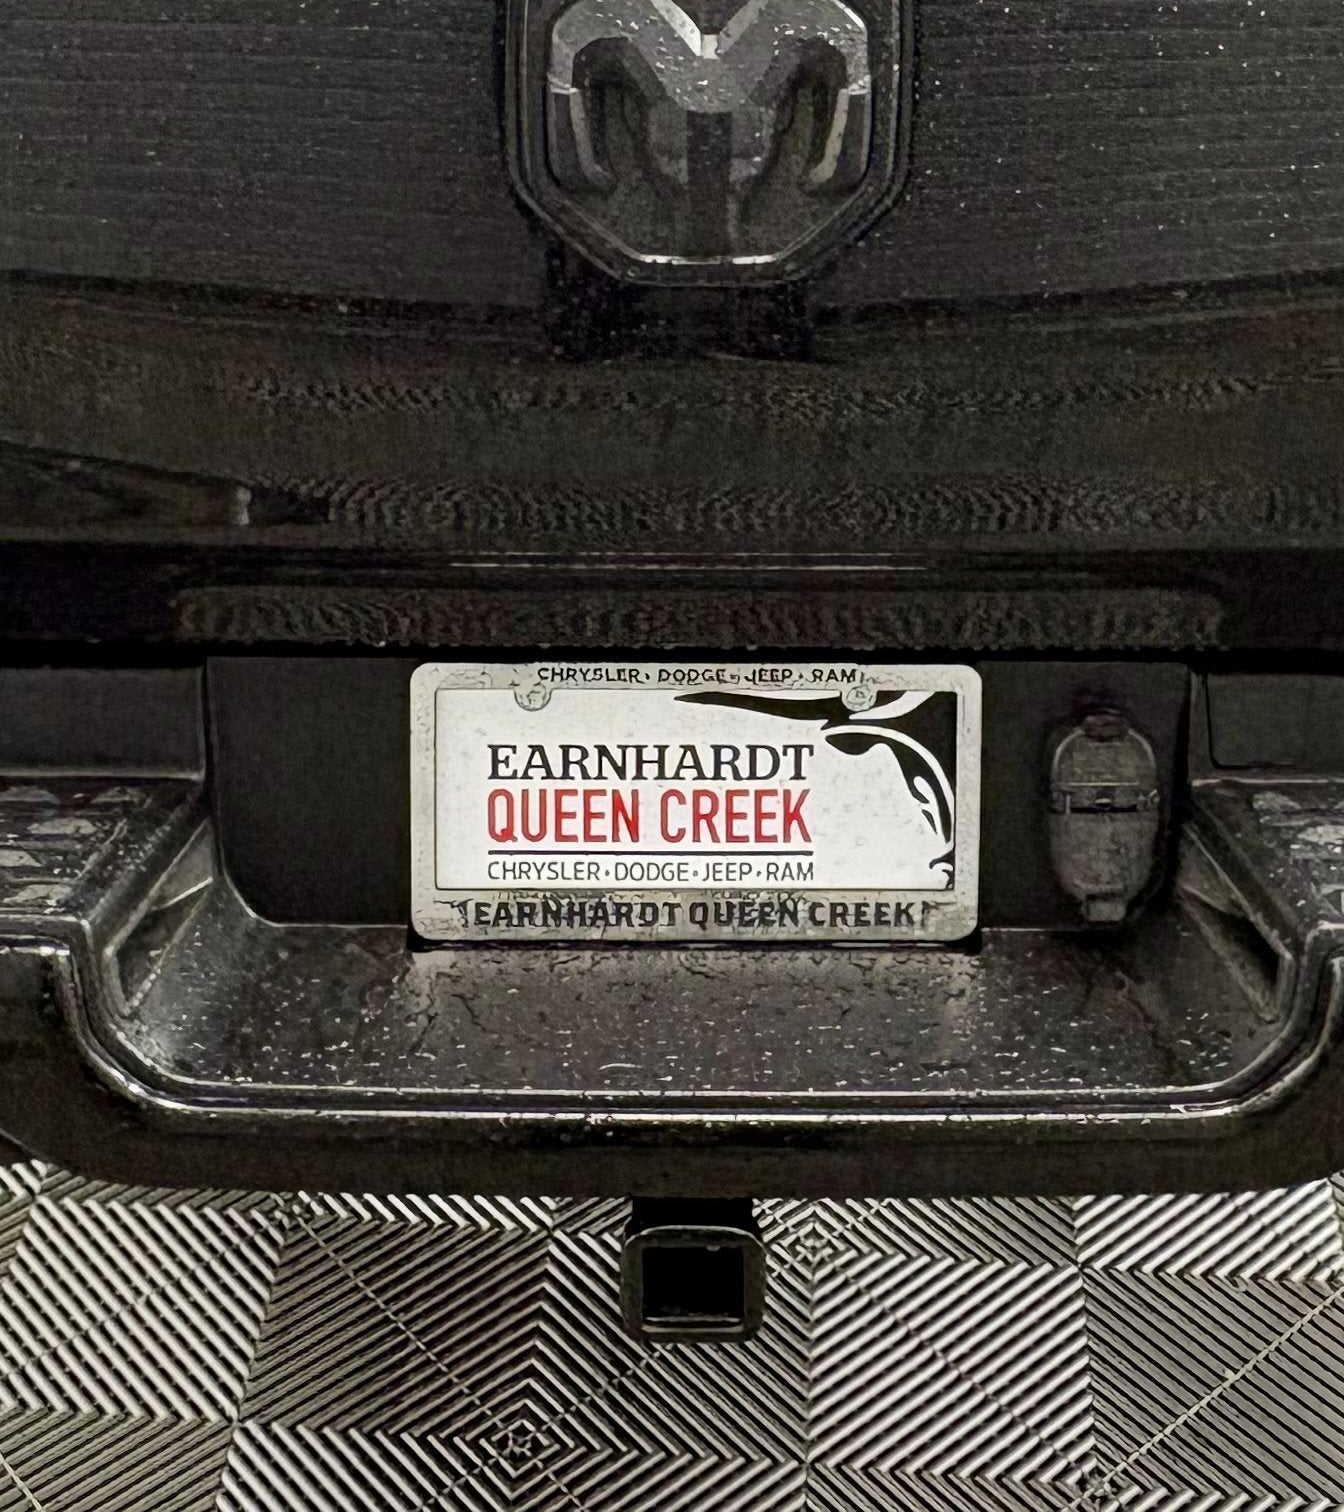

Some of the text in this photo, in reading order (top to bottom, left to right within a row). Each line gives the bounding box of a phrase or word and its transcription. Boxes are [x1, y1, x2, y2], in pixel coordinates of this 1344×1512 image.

[811, 668, 857, 683] RAM
[487, 744, 814, 781] EARNHARDT
[487, 789, 812, 843] QUEEN CREEK
[766, 862, 814, 881] RAM
[474, 901, 915, 931] EARNHARDT QUEEN CREEK
